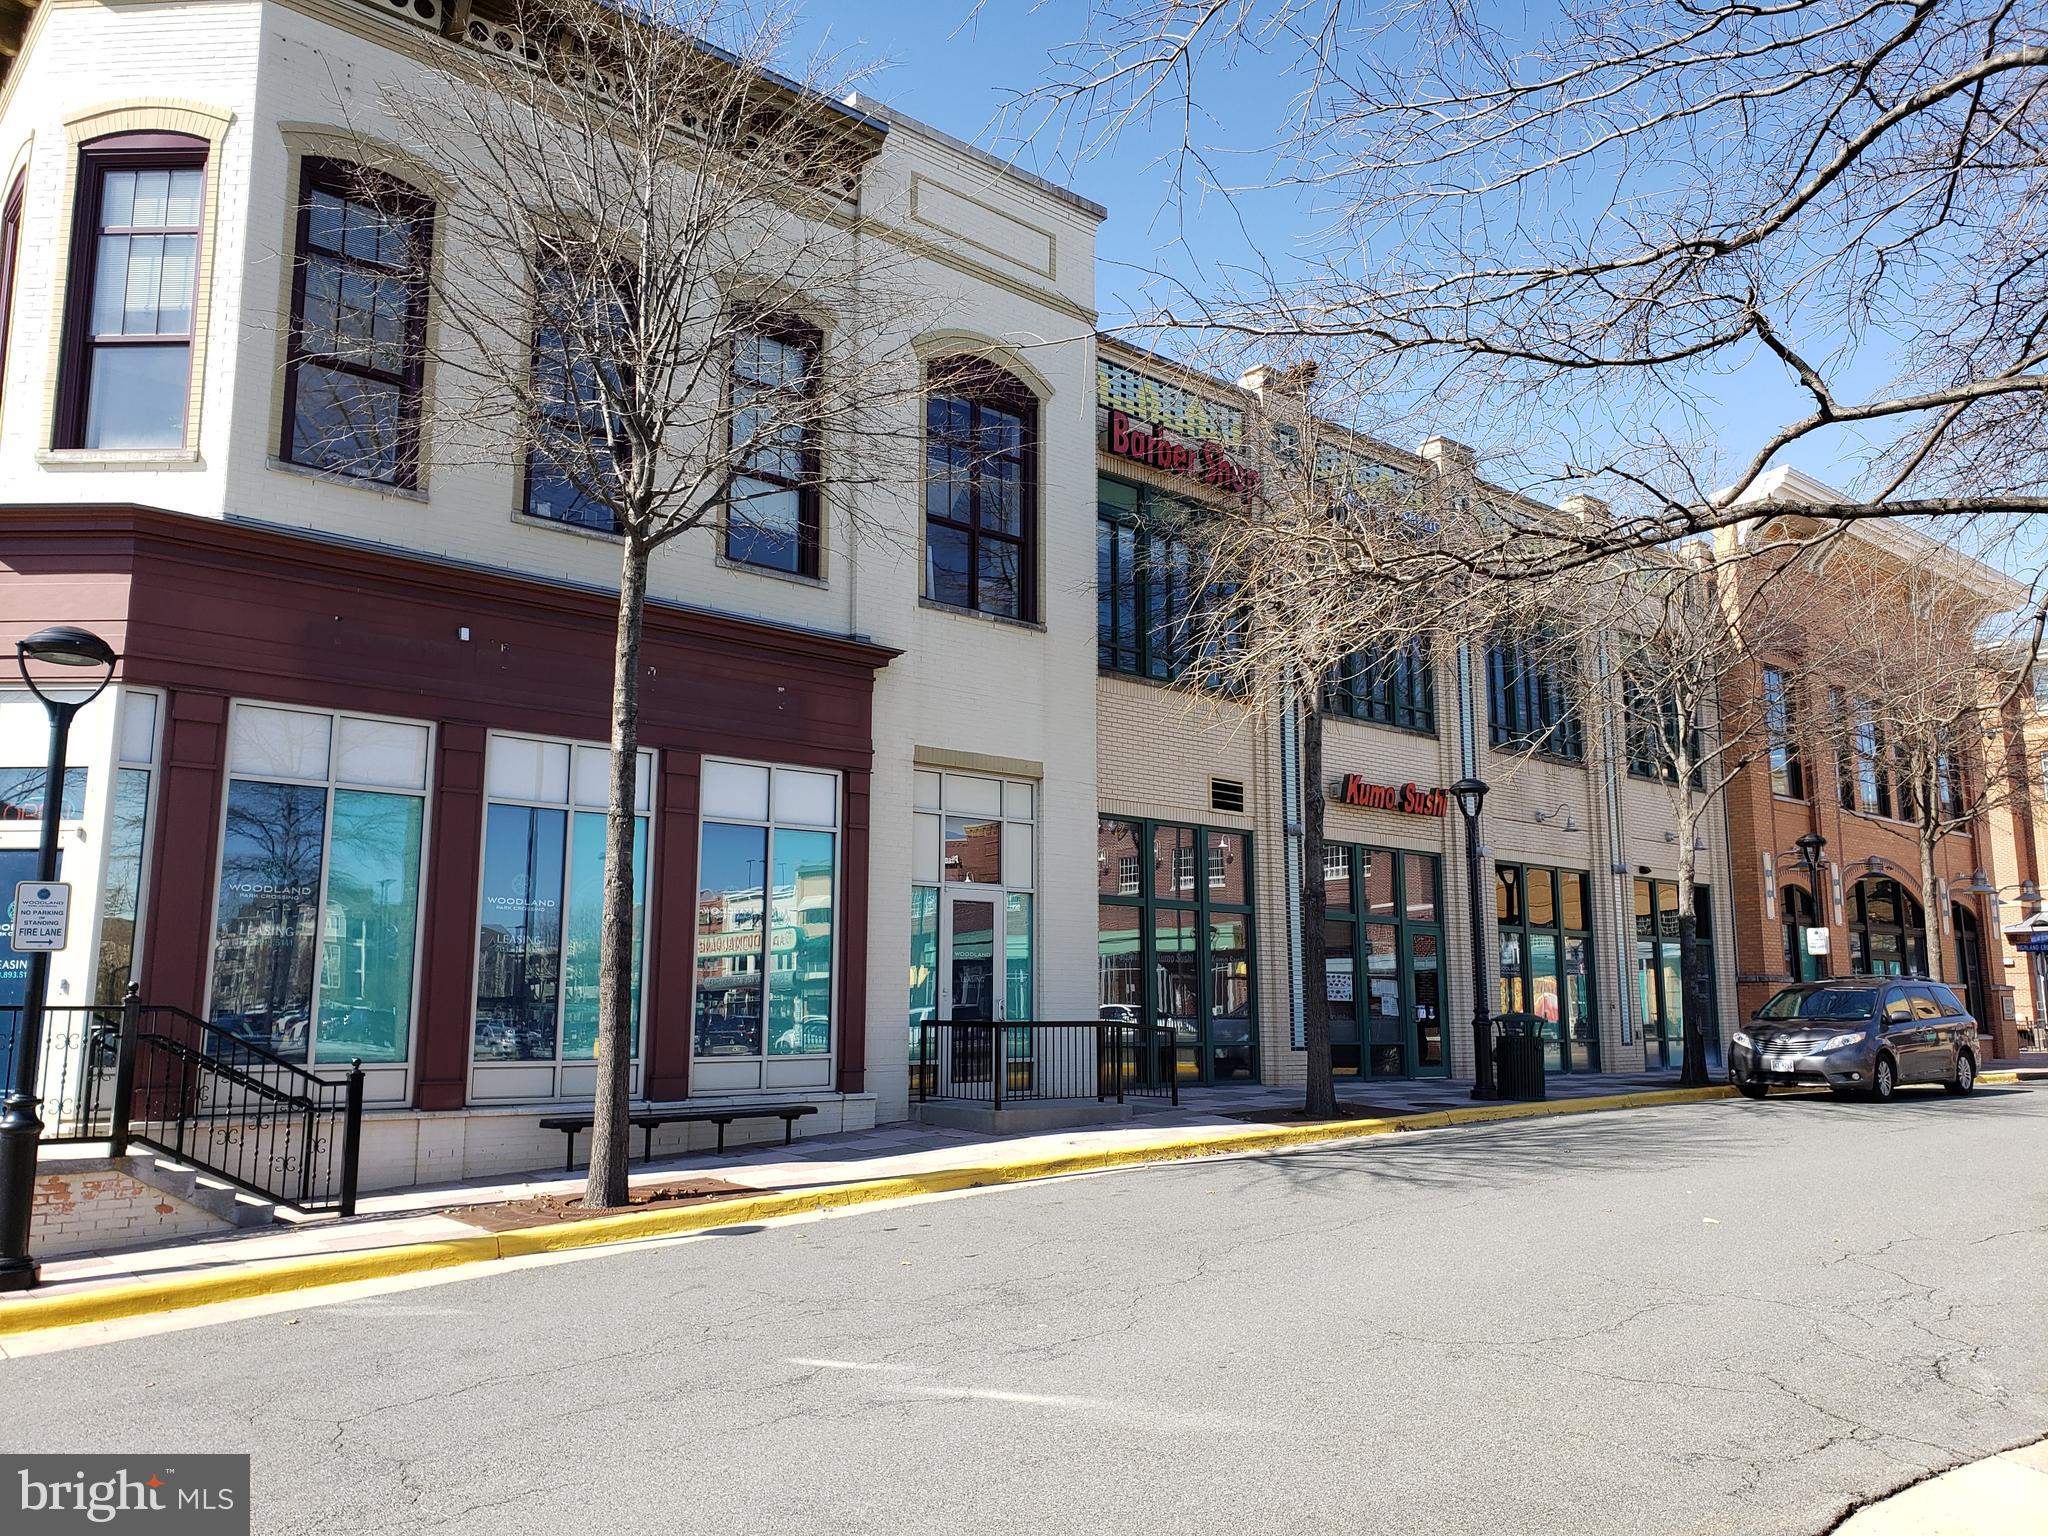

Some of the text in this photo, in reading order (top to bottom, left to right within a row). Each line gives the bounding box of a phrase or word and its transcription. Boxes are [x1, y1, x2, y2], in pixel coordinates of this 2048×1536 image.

[1109, 411, 1260, 504] Barber Shop
[1343, 773, 1449, 817] Kumo Sushi
[229, 883, 312, 896] WOODLAND
[260, 893, 300, 901] CROSSING
[487, 896, 555, 907] WOODLAND
[19, 928, 38, 937] FIRE
[40, 928, 62, 937] LANE
[240, 922, 295, 937] LEASING
[497, 934, 541, 945] LEASING
[954, 951, 991, 959] WOODLAND
